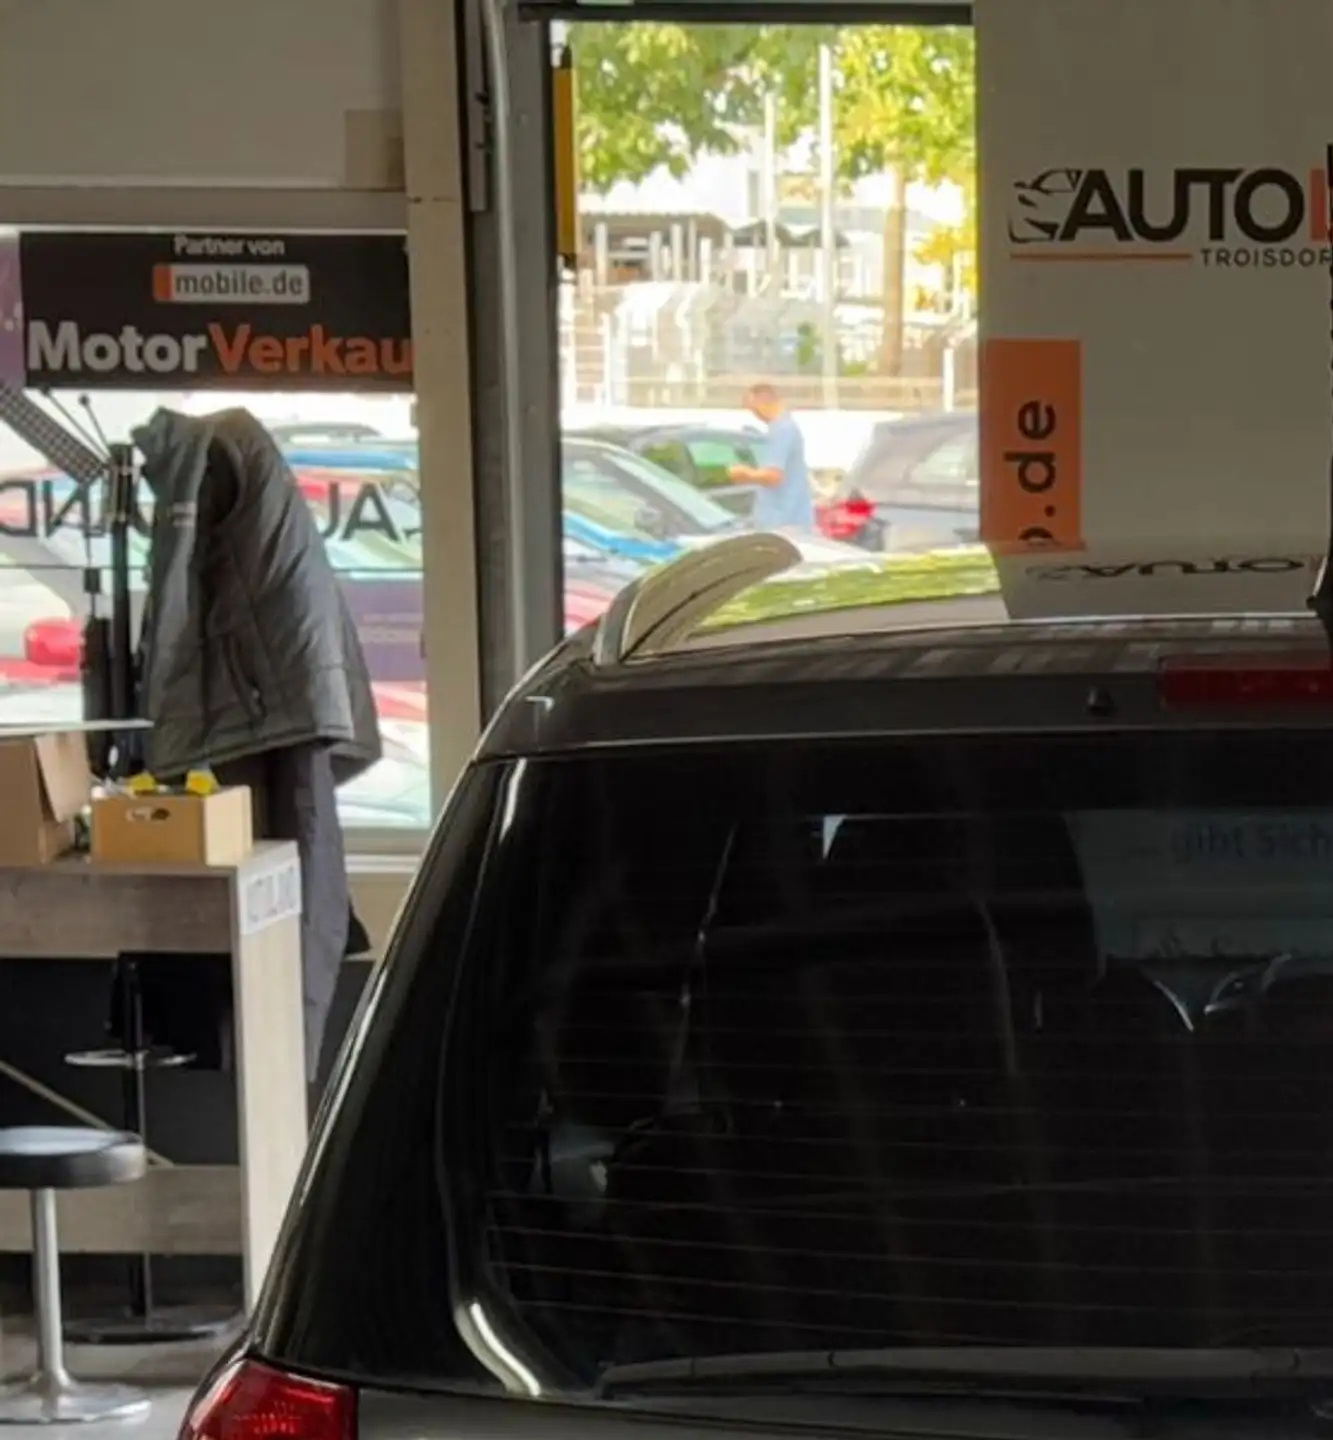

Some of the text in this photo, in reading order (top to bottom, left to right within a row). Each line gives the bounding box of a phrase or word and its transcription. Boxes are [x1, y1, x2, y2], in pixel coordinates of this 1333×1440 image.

[173, 236, 285, 256] Partner von
[174, 270, 304, 297] mobile.de
[27, 320, 415, 373] MotorVerkau
